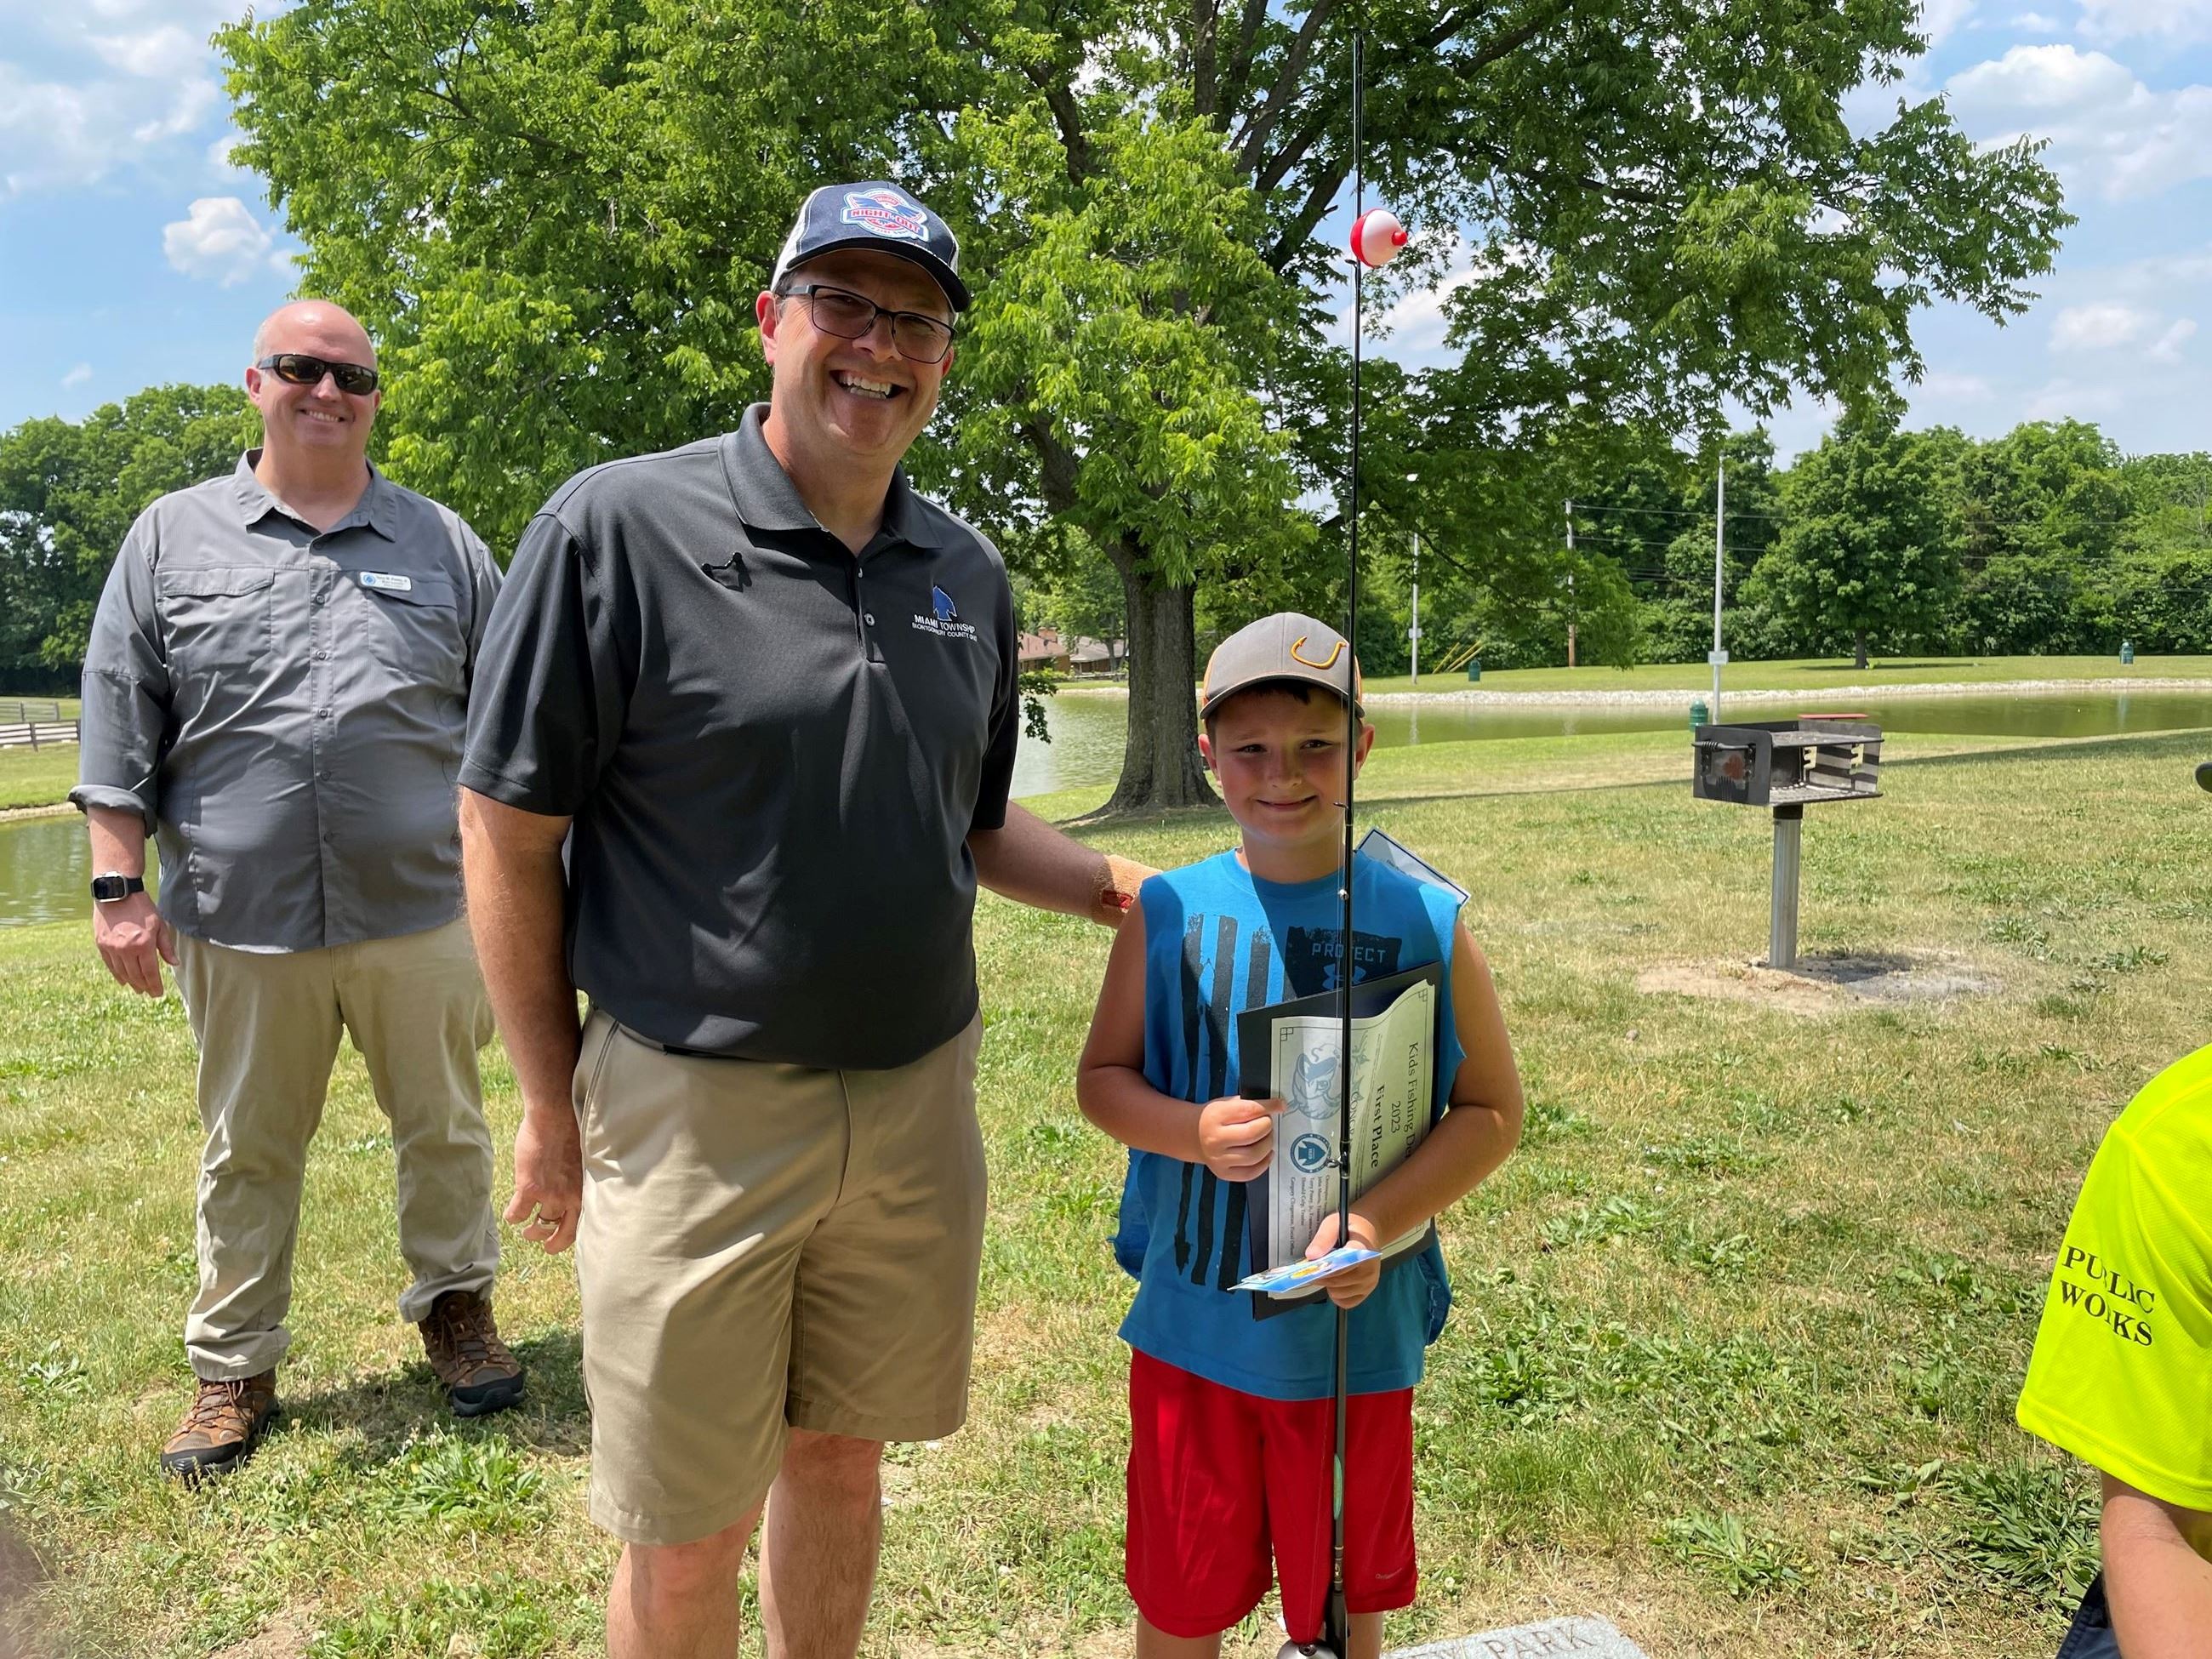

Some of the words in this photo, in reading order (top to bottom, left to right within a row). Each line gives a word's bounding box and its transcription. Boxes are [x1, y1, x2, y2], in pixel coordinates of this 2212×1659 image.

[851, 209, 890, 220] NIGHT
[895, 215, 921, 234] OUT
[914, 614, 938, 629] MIAMI
[939, 621, 976, 634] TOWNSHIP
[1312, 943, 1386, 963] PROECT
[1408, 1041, 1418, 1077] Kids
[1373, 1084, 1385, 1123] First
[1391, 1100, 1401, 1134] 2023
[1404, 1079, 1418, 1132] Fishing
[1371, 1126, 1382, 1169] Place
[1483, 1623, 1597, 1659] PARK
